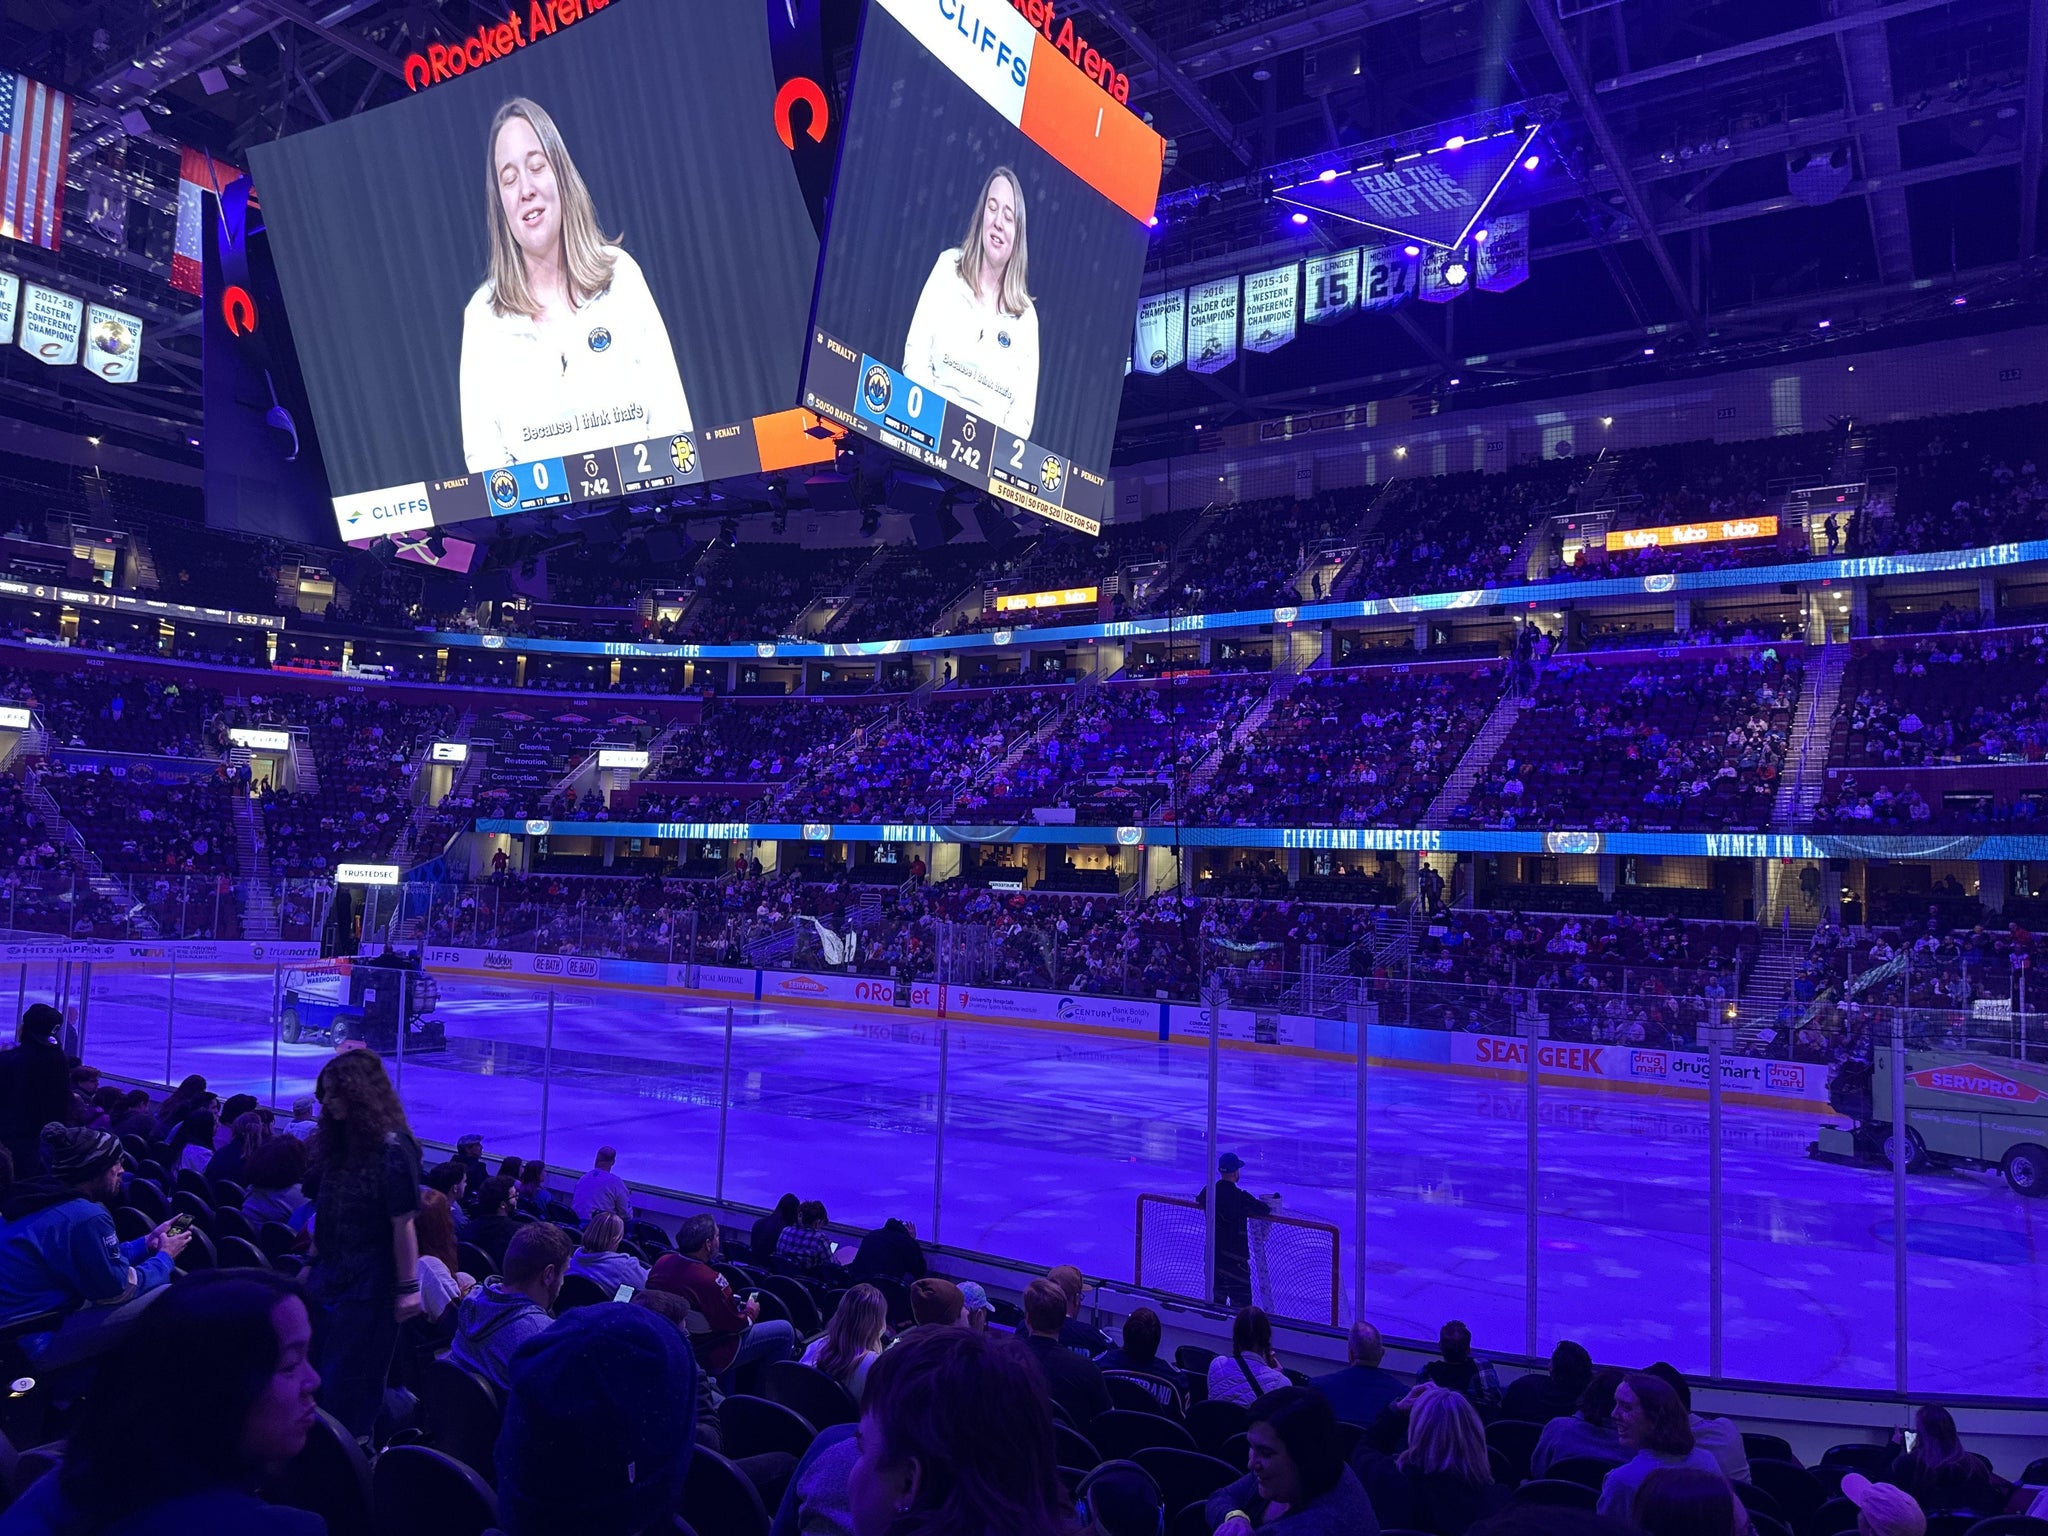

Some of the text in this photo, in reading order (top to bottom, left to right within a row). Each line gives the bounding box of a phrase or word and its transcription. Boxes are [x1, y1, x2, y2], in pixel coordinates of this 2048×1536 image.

[427, 10, 526, 83] Rocket
[938, 0, 1027, 87] CLIFFS
[1056, 17, 1130, 104] Arena
[1351, 163, 1450, 194] FEAR THE
[1362, 177, 1477, 219] DEPTHS
[1310, 257, 1354, 275] CALLANDER
[1252, 273, 1290, 290] 2015-16
[1314, 270, 1350, 310] 15
[1369, 264, 1408, 299] 27
[35, 290, 74, 310] 2017-18
[1203, 285, 1224, 299] 2016
[1253, 287, 1289, 303] WESTERN
[35, 303, 71, 320] EASTERN
[1140, 303, 1181, 320] CHAMPIONS
[1191, 296, 1236, 316] CALDER CUP
[1246, 297, 1294, 316] CONFERENCE
[27, 311, 77, 333] CONFERENCE
[1191, 310, 1235, 327] CHAMPIONS
[1247, 310, 1291, 326] CHAMPIONS
[28, 322, 74, 343] CHAMPIONS
[827, 338, 857, 363] PENALTY
[2000, 370, 2021, 380] 212
[907, 386, 923, 419] 0
[522, 402, 644, 441] Because I think that's
[815, 399, 858, 428] 50/50 RAFFLE
[714, 426, 741, 439] PENALTY
[900, 423, 908, 434] 17
[633, 443, 652, 473] 2
[951, 439, 981, 470] 7:42
[1009, 438, 1025, 470] 2
[443, 477, 469, 490] PENALTY
[532, 462, 549, 490] 0
[665, 477, 673, 485] 17
[580, 478, 610, 497] 7:42
[1030, 483, 1038, 493] 17
[372, 499, 428, 520] CLIFFS
[537, 498, 543, 506] 17
[998, 484, 1097, 533] 5 FOR $10 50 FOR $20 125 FOR $40
[1624, 523, 1759, 547] fubo fubo fubo
[35, 586, 44, 597] 6
[93, 594, 110, 606] 17
[237, 615, 257, 624] 6:53
[519, 743, 551, 751] Cleaning.
[505, 757, 548, 766] Restoration.
[658, 823, 749, 839] CLEVELAND MONSTERS
[883, 825, 913, 841] WOMEN
[917, 826, 926, 841] IN
[1283, 829, 1440, 850] CLEVELAND MONSTERS
[1706, 834, 1767, 857] WOMEN
[1776, 834, 1793, 857] IN
[344, 870, 393, 878] TRUSTEDSEC
[269, 947, 318, 956] truenorth
[307, 975, 340, 985] WAREHOUSE
[789, 980, 818, 991] SERVPRO
[872, 983, 930, 1005] Roet
[1075, 1008, 1112, 1018] CENTURY
[1112, 1006, 1149, 1017] Bank Boldly
[1112, 1015, 1143, 1025] Live Fully
[1634, 1052, 1661, 1067] drug
[1636, 1064, 1664, 1075] mart
[1672, 1059, 1761, 1080] drug mart
[1769, 1065, 1797, 1081] drug
[1771, 1077, 1802, 1088] mart
[1931, 1072, 2018, 1096] SERVPRO
[1991, 1122, 2045, 1136] Construction
